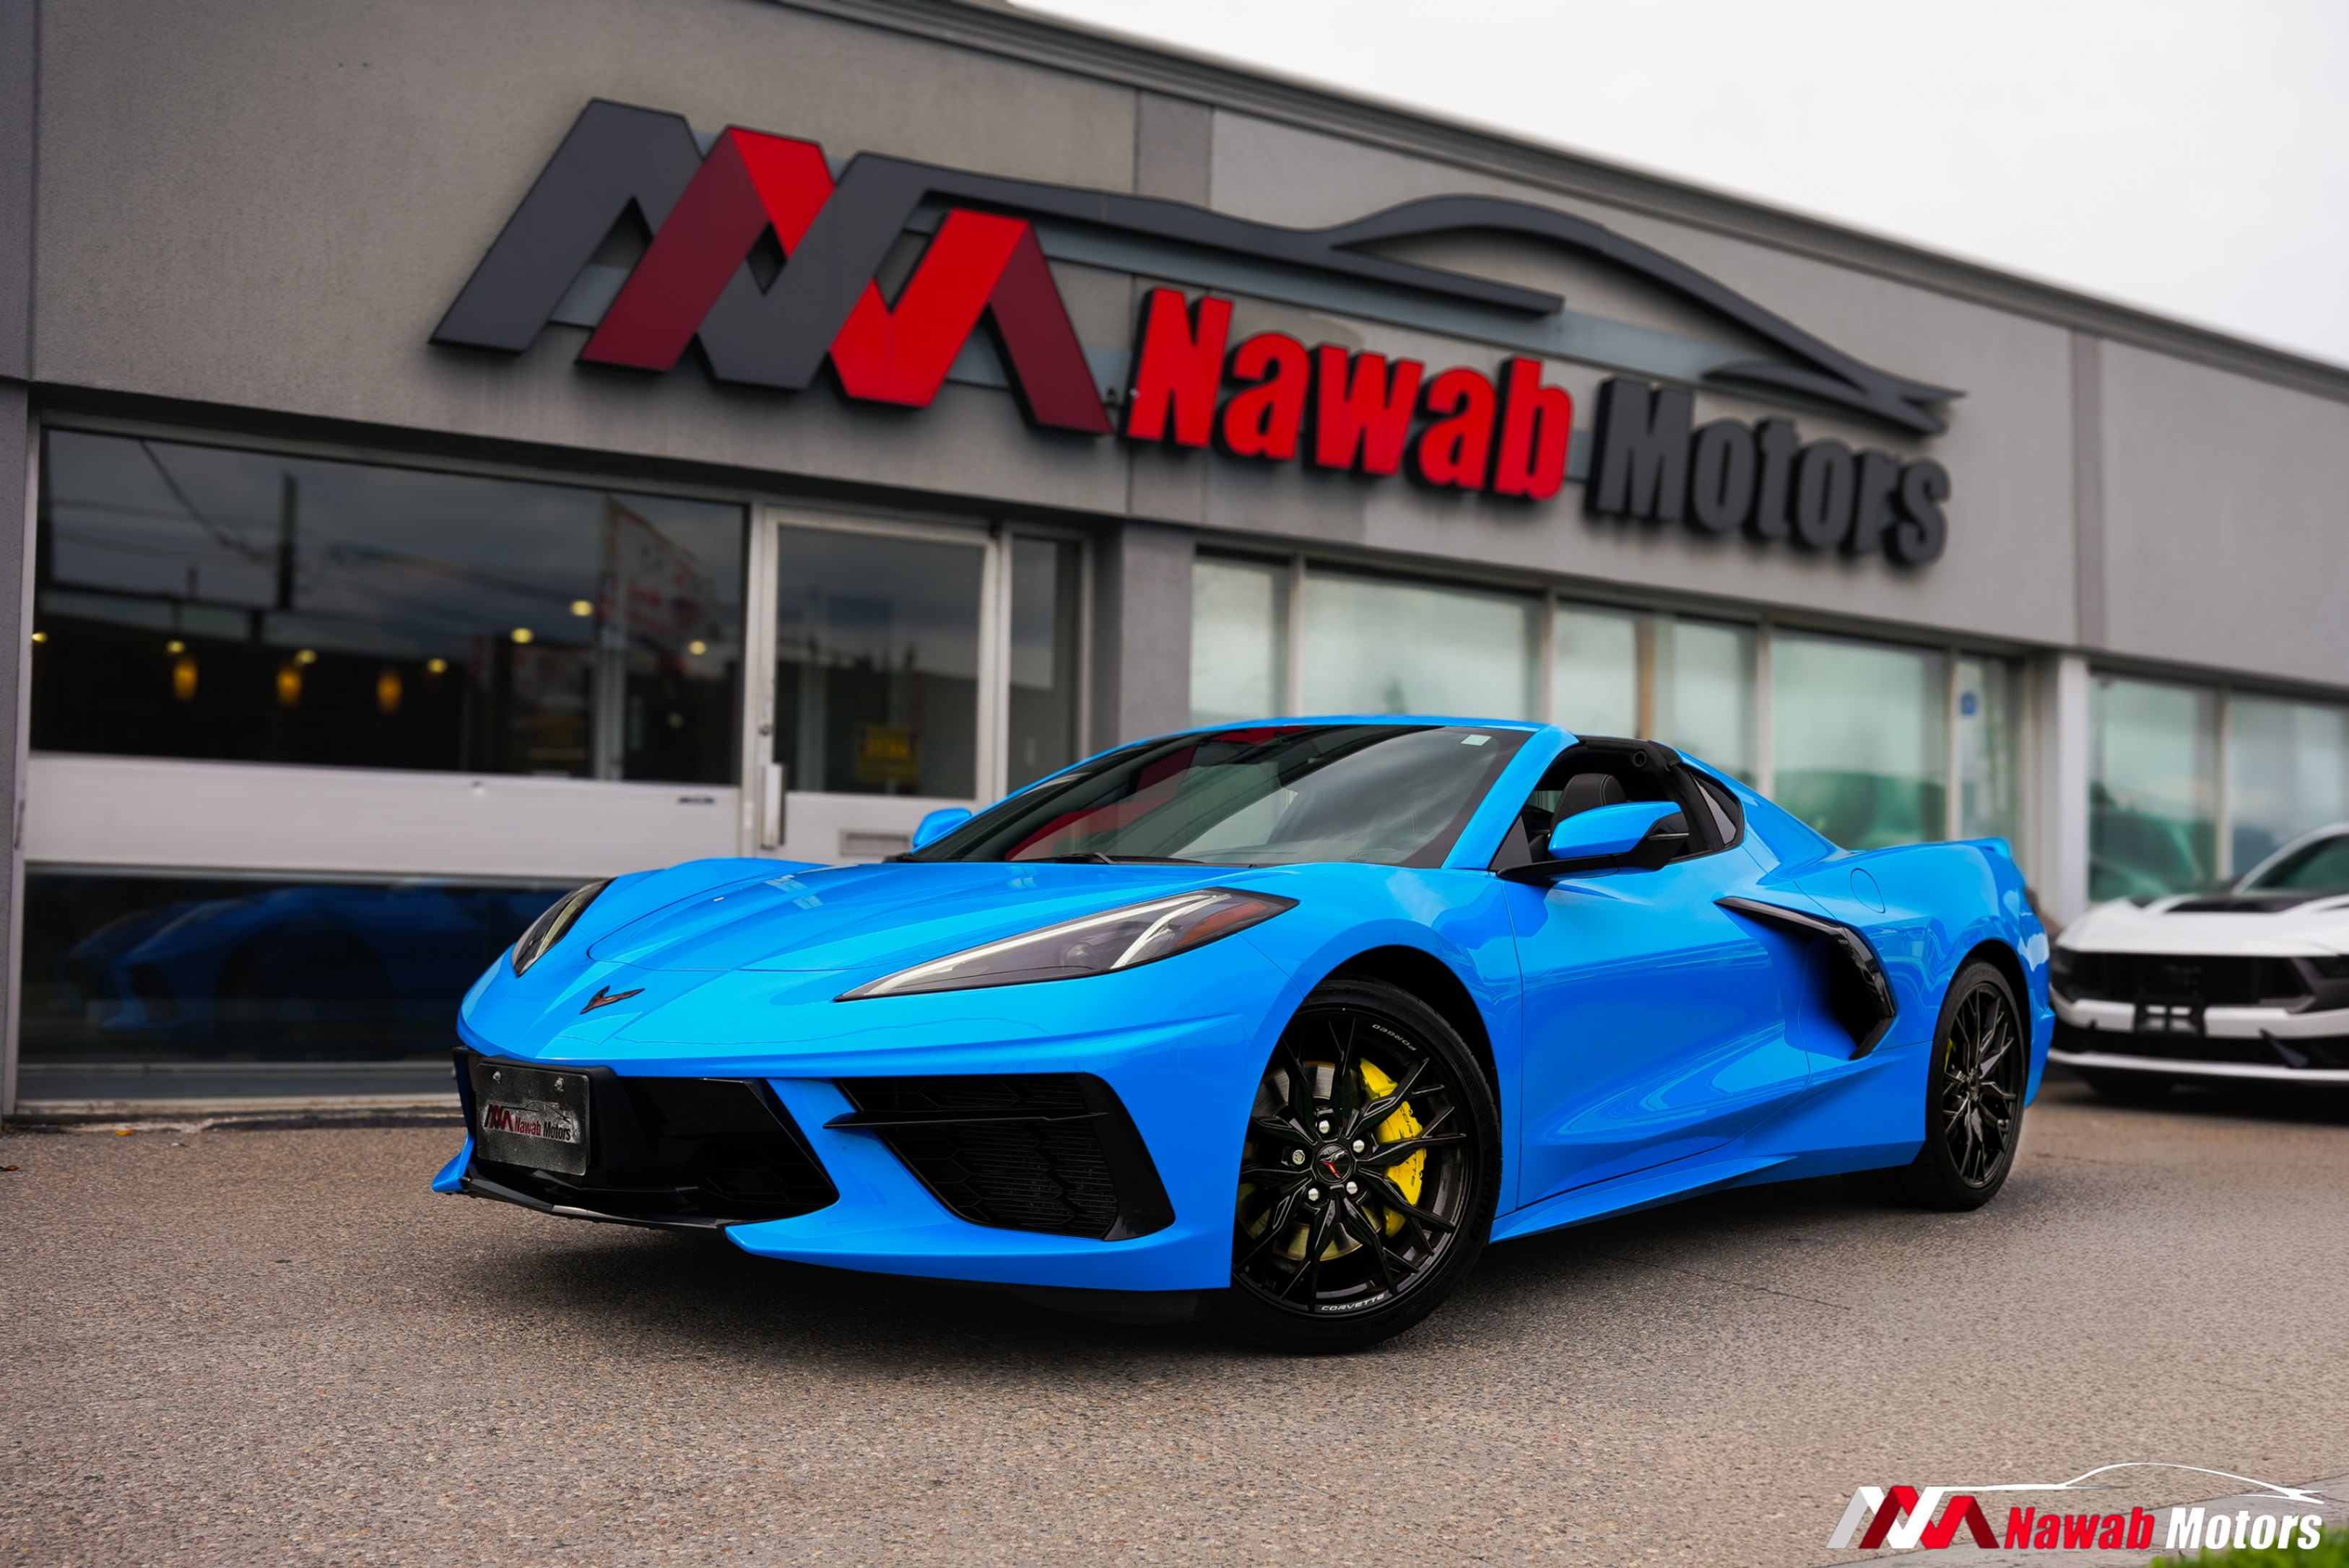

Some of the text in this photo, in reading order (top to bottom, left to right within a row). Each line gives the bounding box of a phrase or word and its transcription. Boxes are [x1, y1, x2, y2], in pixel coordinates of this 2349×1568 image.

[1126, 287, 1950, 565] Nawab Motors
[1372, 1024, 1417, 1051] FORGED
[515, 1117, 542, 1136] Nawab
[543, 1120, 571, 1141] Motors
[1399, 1105, 1417, 1188] CORTTE
[1321, 1292, 1386, 1312] CORVETTE
